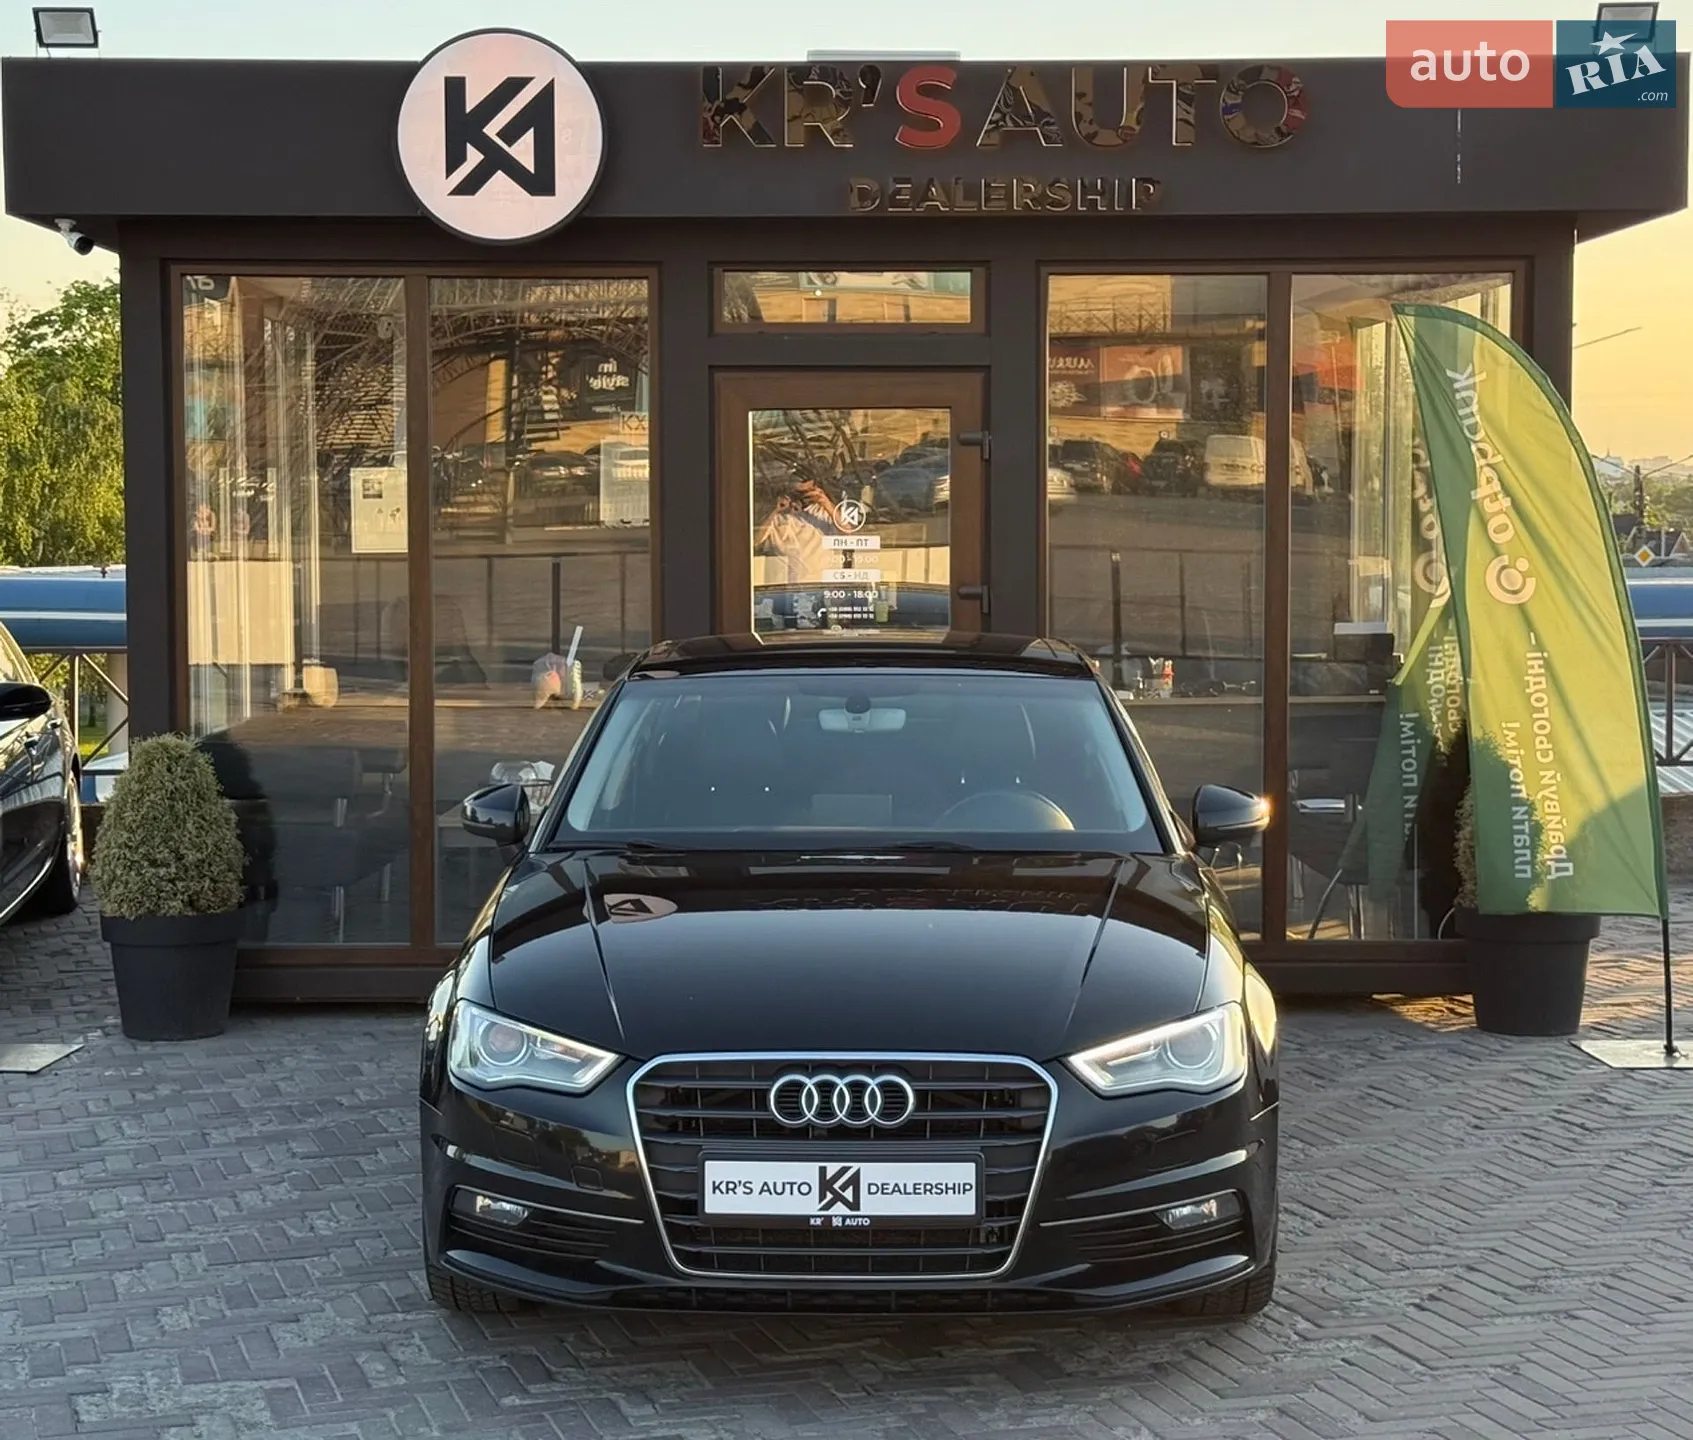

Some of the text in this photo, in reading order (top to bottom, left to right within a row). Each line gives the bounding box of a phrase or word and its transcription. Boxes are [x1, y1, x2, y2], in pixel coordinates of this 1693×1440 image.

[976, 64, 1307, 148] AUTO
[849, 177, 1162, 212] DEALERSHIP
[823, 590, 846, 599] 9:00
[853, 590, 879, 599] 18:00
[711, 1180, 754, 1196] KR'S
[758, 1181, 812, 1197] AUTO
[867, 1183, 974, 1197] DEALERSHIP
[844, 1217, 871, 1227] AUTO
